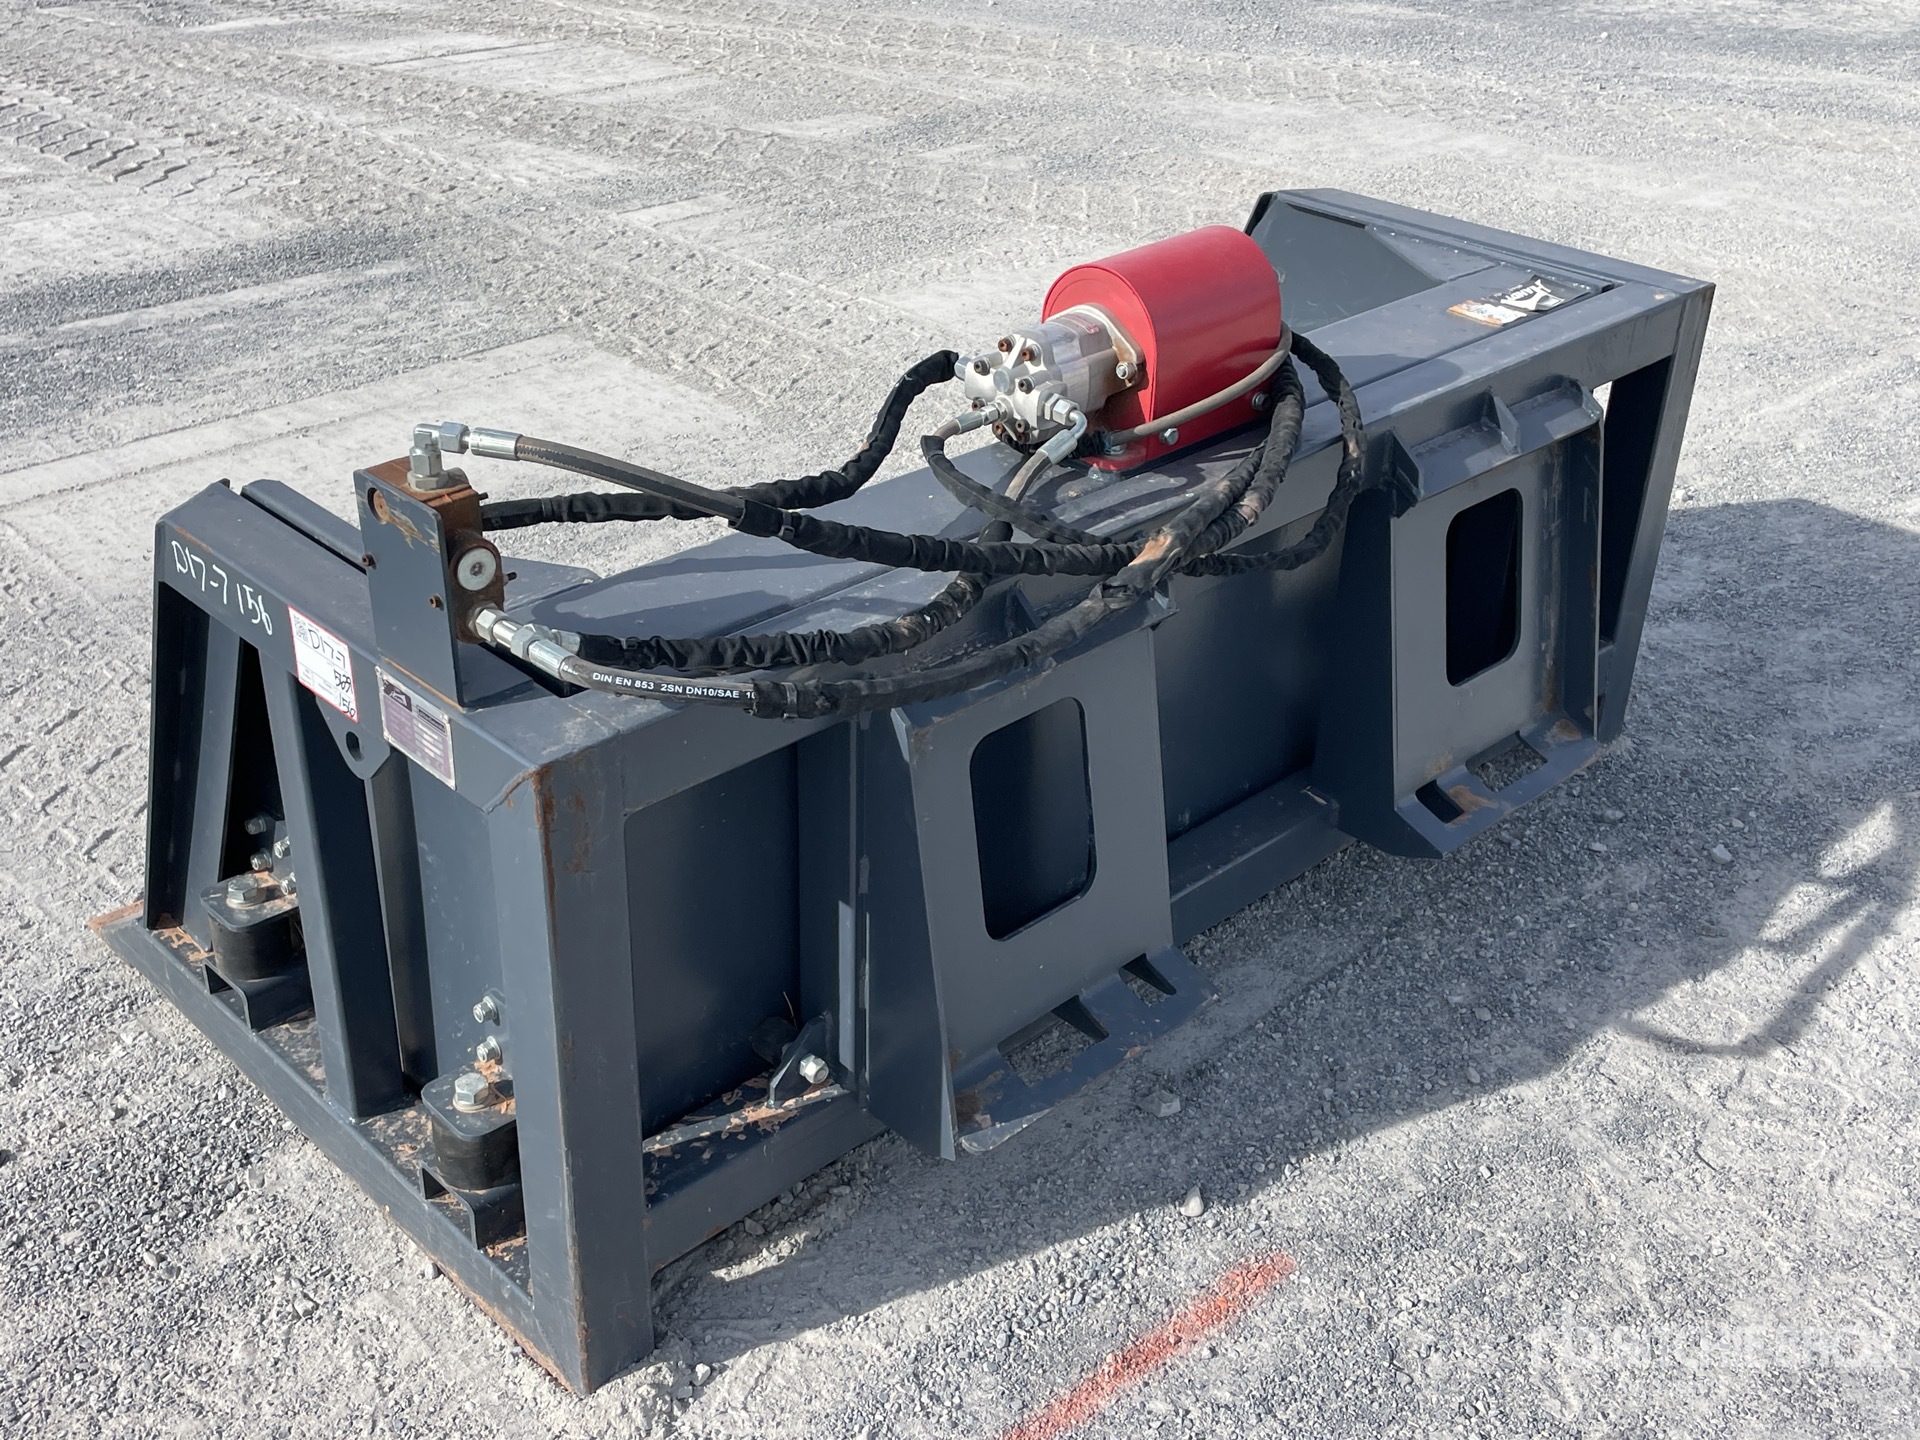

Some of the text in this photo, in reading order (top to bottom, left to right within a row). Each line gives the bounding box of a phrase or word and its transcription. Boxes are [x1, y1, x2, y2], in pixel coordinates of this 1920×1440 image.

[236, 582, 273, 636] 156
[307, 628, 347, 669] D17-7
[592, 672, 613, 684] DIN
[615, 677, 632, 688] EN
[634, 680, 654, 691] 853
[660, 683, 683, 694] 2SN
[685, 686, 740, 699] DN10/SAE
